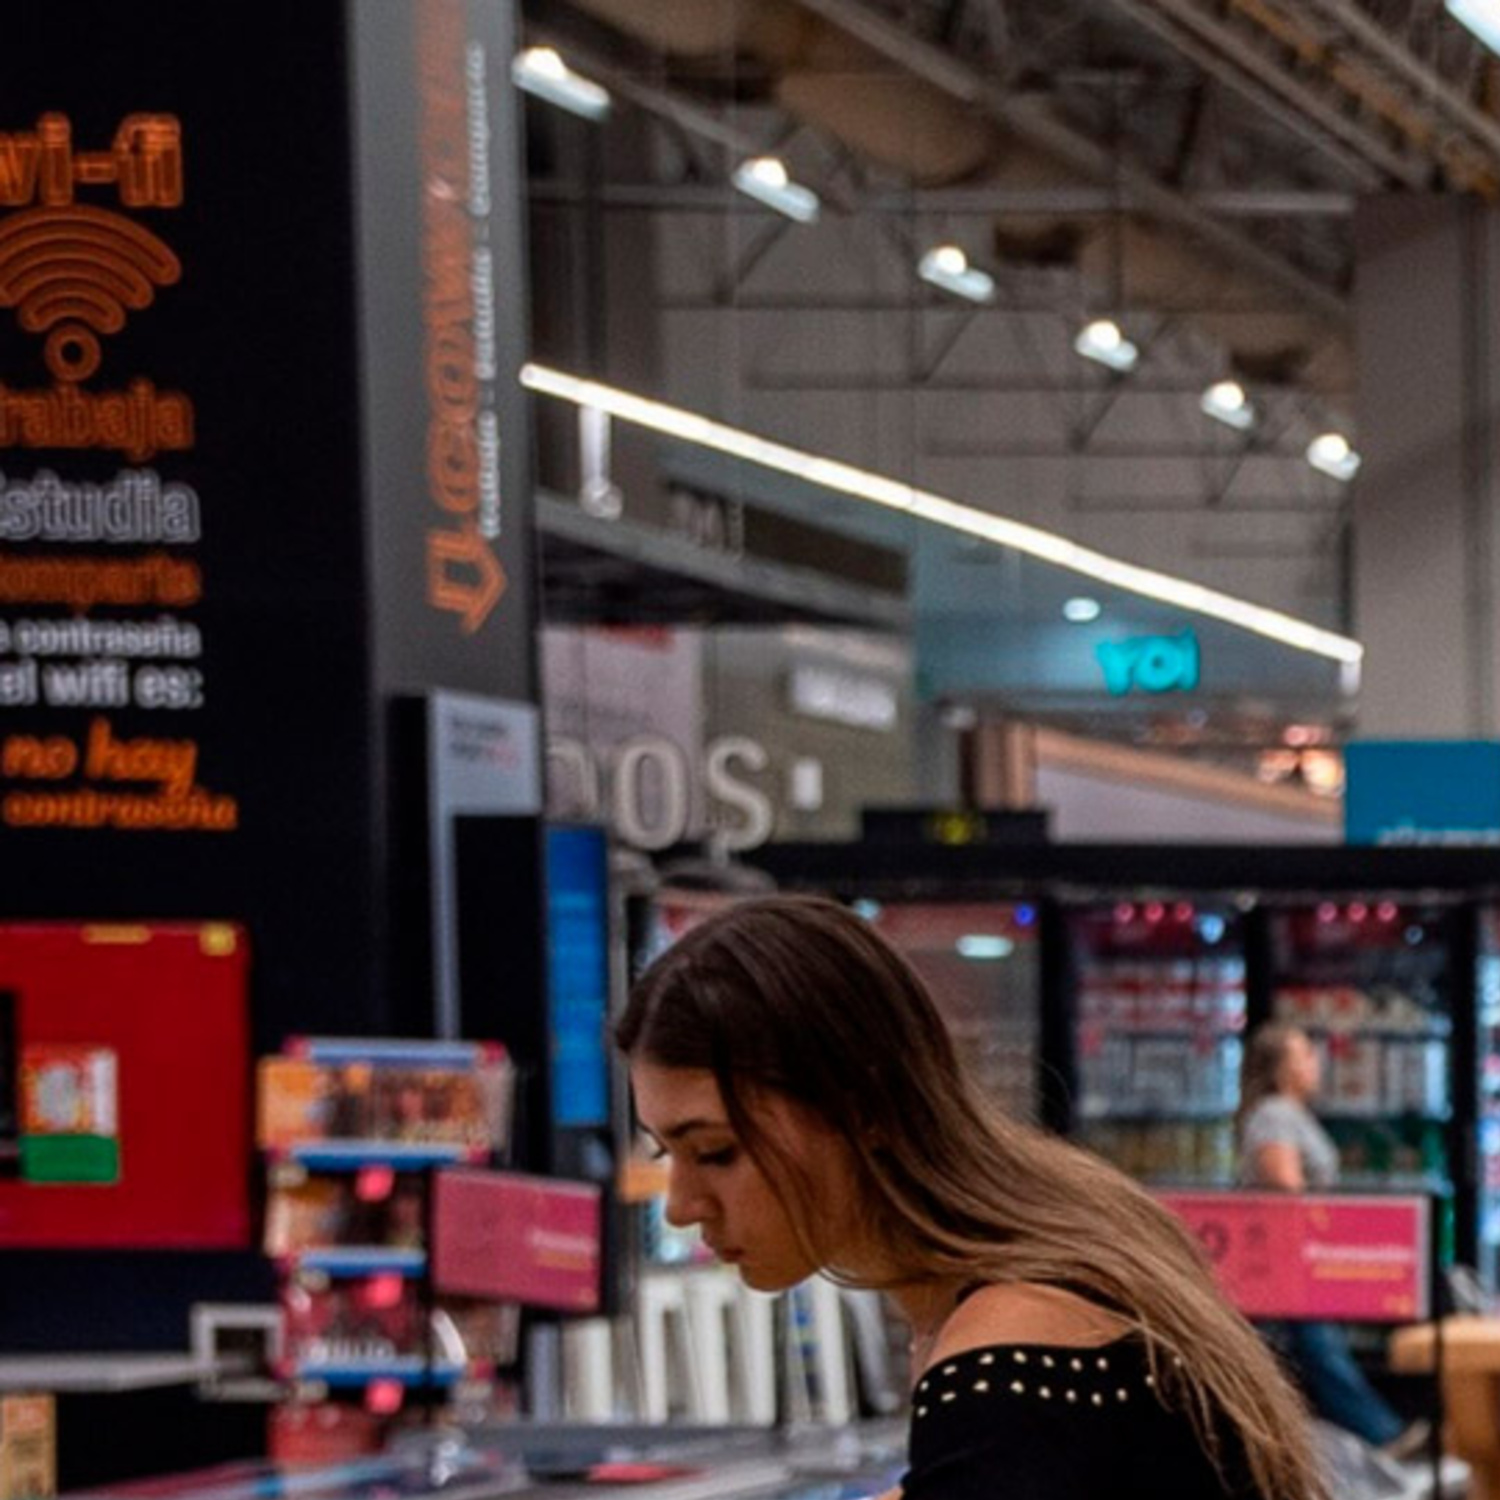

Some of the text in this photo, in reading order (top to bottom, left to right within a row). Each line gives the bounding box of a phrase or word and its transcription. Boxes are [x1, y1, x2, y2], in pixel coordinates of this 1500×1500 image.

[0, 378, 196, 462] rabaja
[0, 468, 201, 543] studia
[0, 656, 38, 706] el
